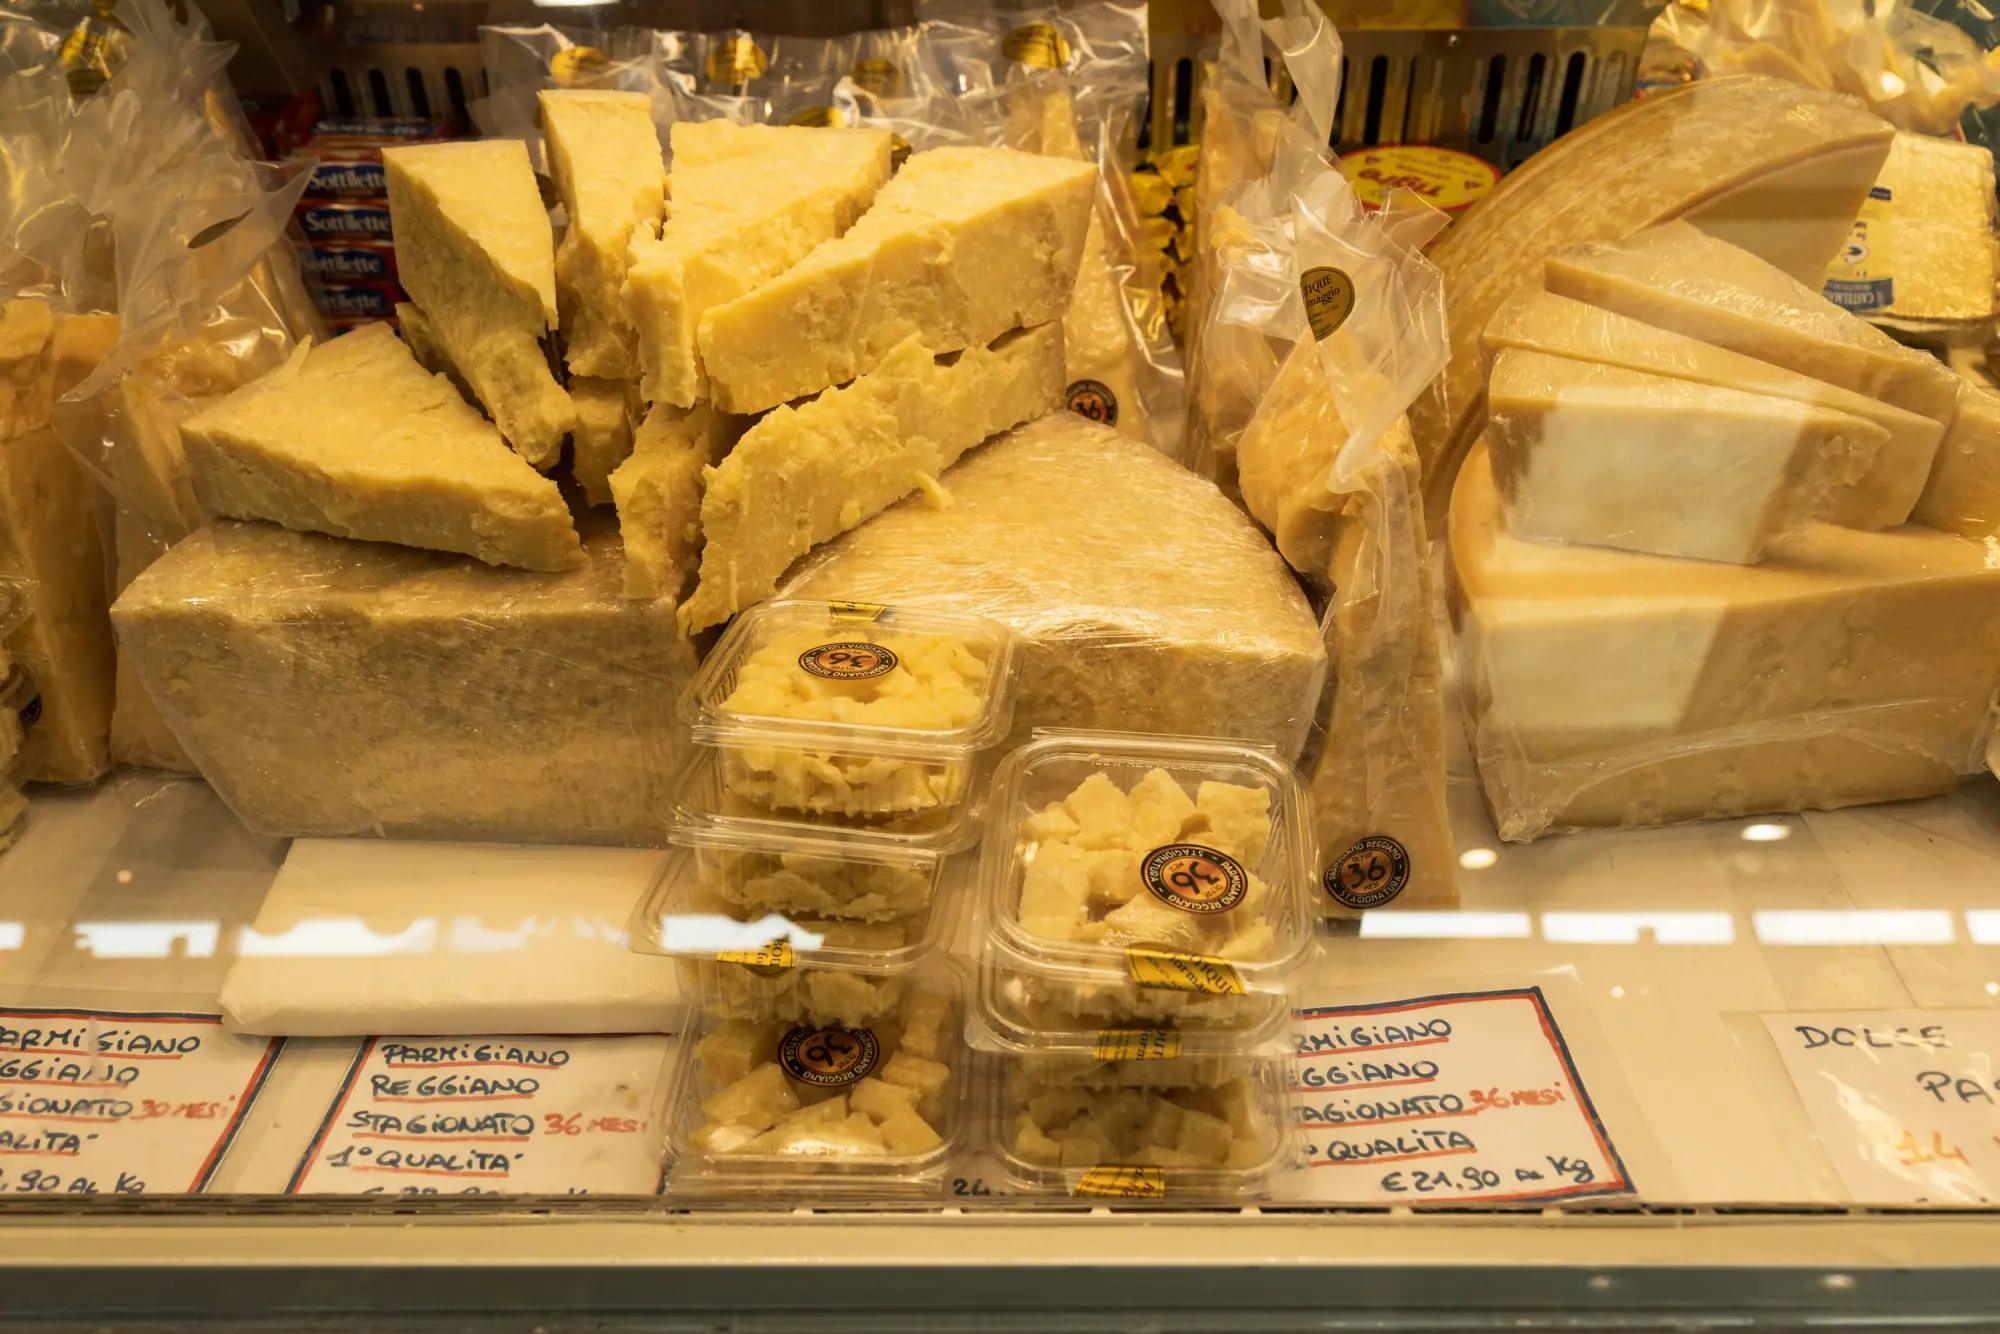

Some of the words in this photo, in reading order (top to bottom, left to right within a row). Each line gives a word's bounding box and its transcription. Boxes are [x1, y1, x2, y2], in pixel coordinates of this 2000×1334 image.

[828, 652, 873, 668] 36
[1366, 840, 1402, 860] REGGIANO
[1148, 849, 1205, 882] STAGIONATURA
[1170, 860, 1221, 895] 36
[1347, 856, 1386, 889] 36
[1220, 861, 1242, 906] PARMIGIANO
[1339, 876, 1403, 904] STAGIONATURA
[1168, 894, 1223, 911] REGGIANO
[806, 1033, 854, 1067] 36
[802, 1070, 855, 1084] REGGIANO
[1915, 1071, 2000, 1105] PA
[1469, 1088, 1510, 1110] 36
[543, 1113, 582, 1136] 36
